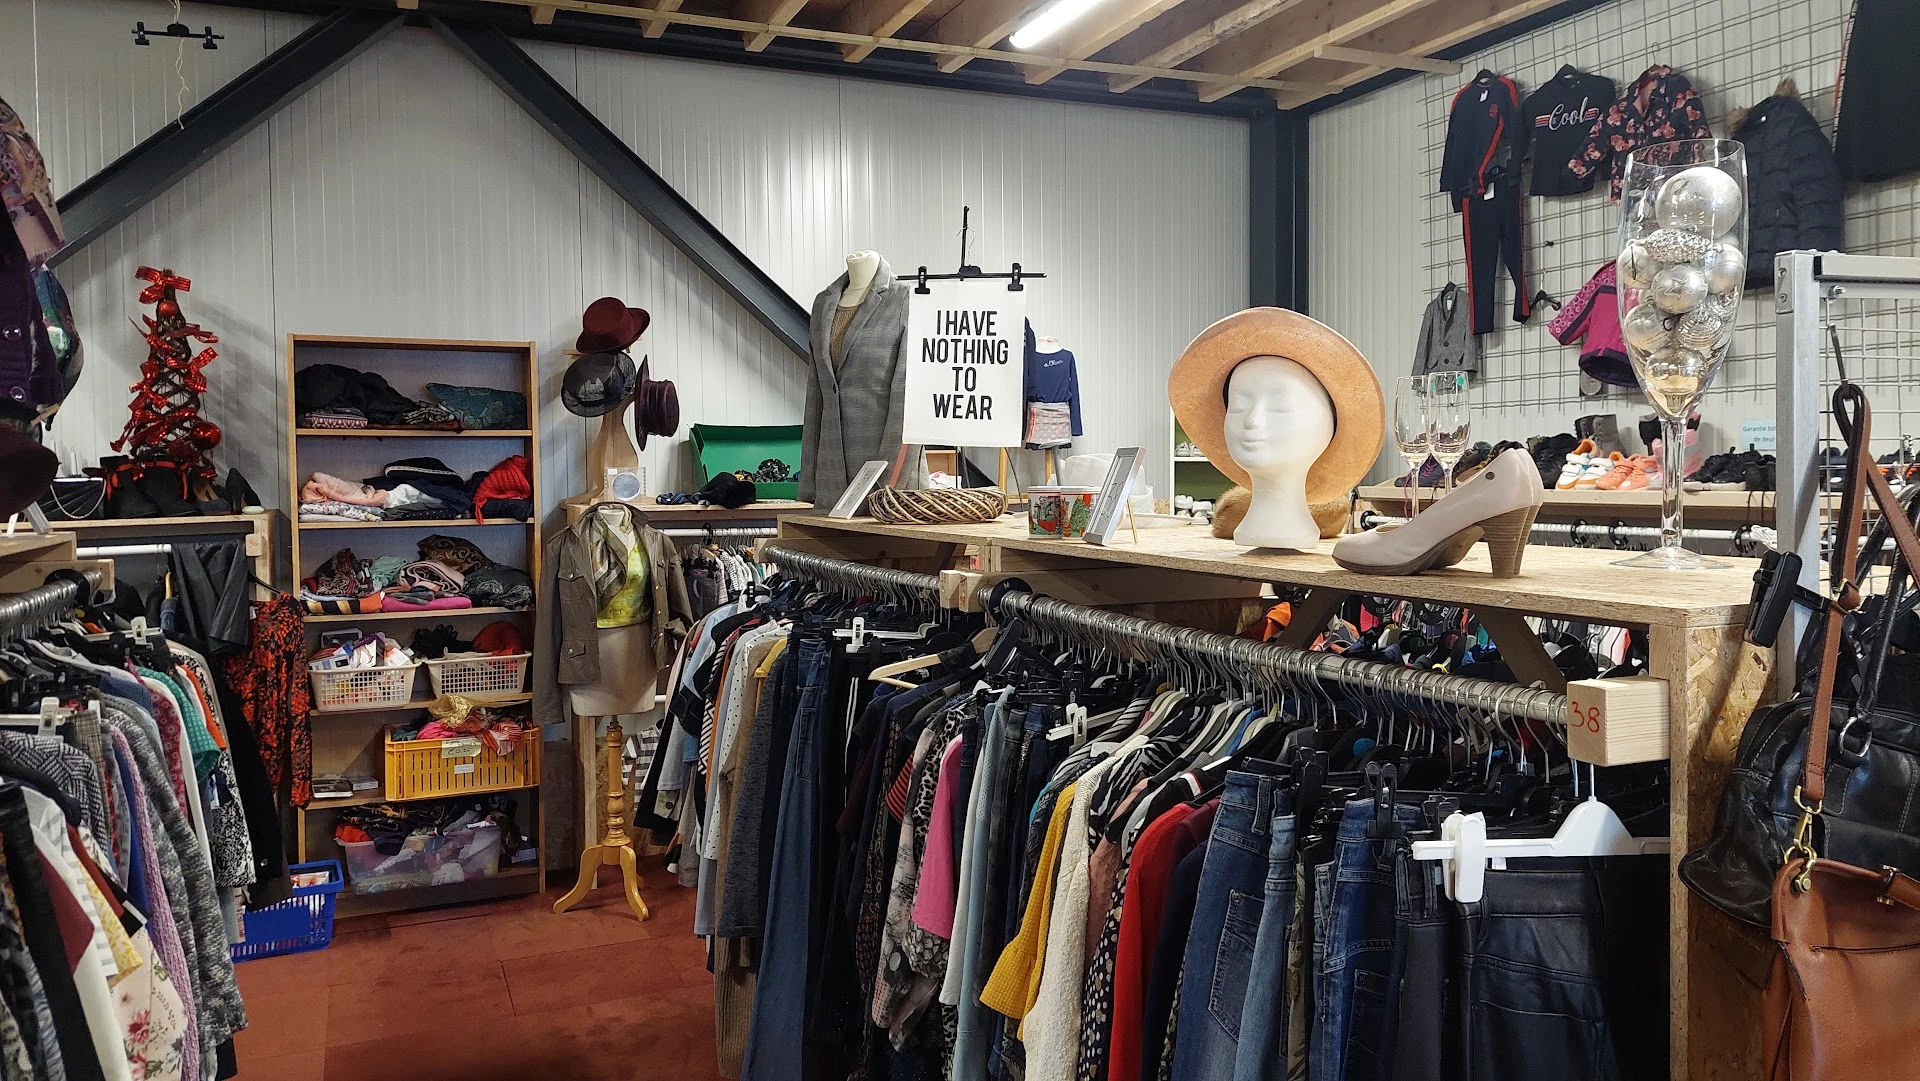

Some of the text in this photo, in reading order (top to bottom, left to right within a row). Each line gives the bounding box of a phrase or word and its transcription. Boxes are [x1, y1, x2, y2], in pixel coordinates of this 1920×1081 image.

[1549, 96, 1588, 131] Cool
[936, 310, 998, 336] I HAVE
[922, 338, 1009, 365] NOTHING
[952, 366, 977, 392] TO
[933, 393, 993, 420] WEAR
[1003, 581, 1011, 590] M
[1571, 701, 1600, 732] 38
